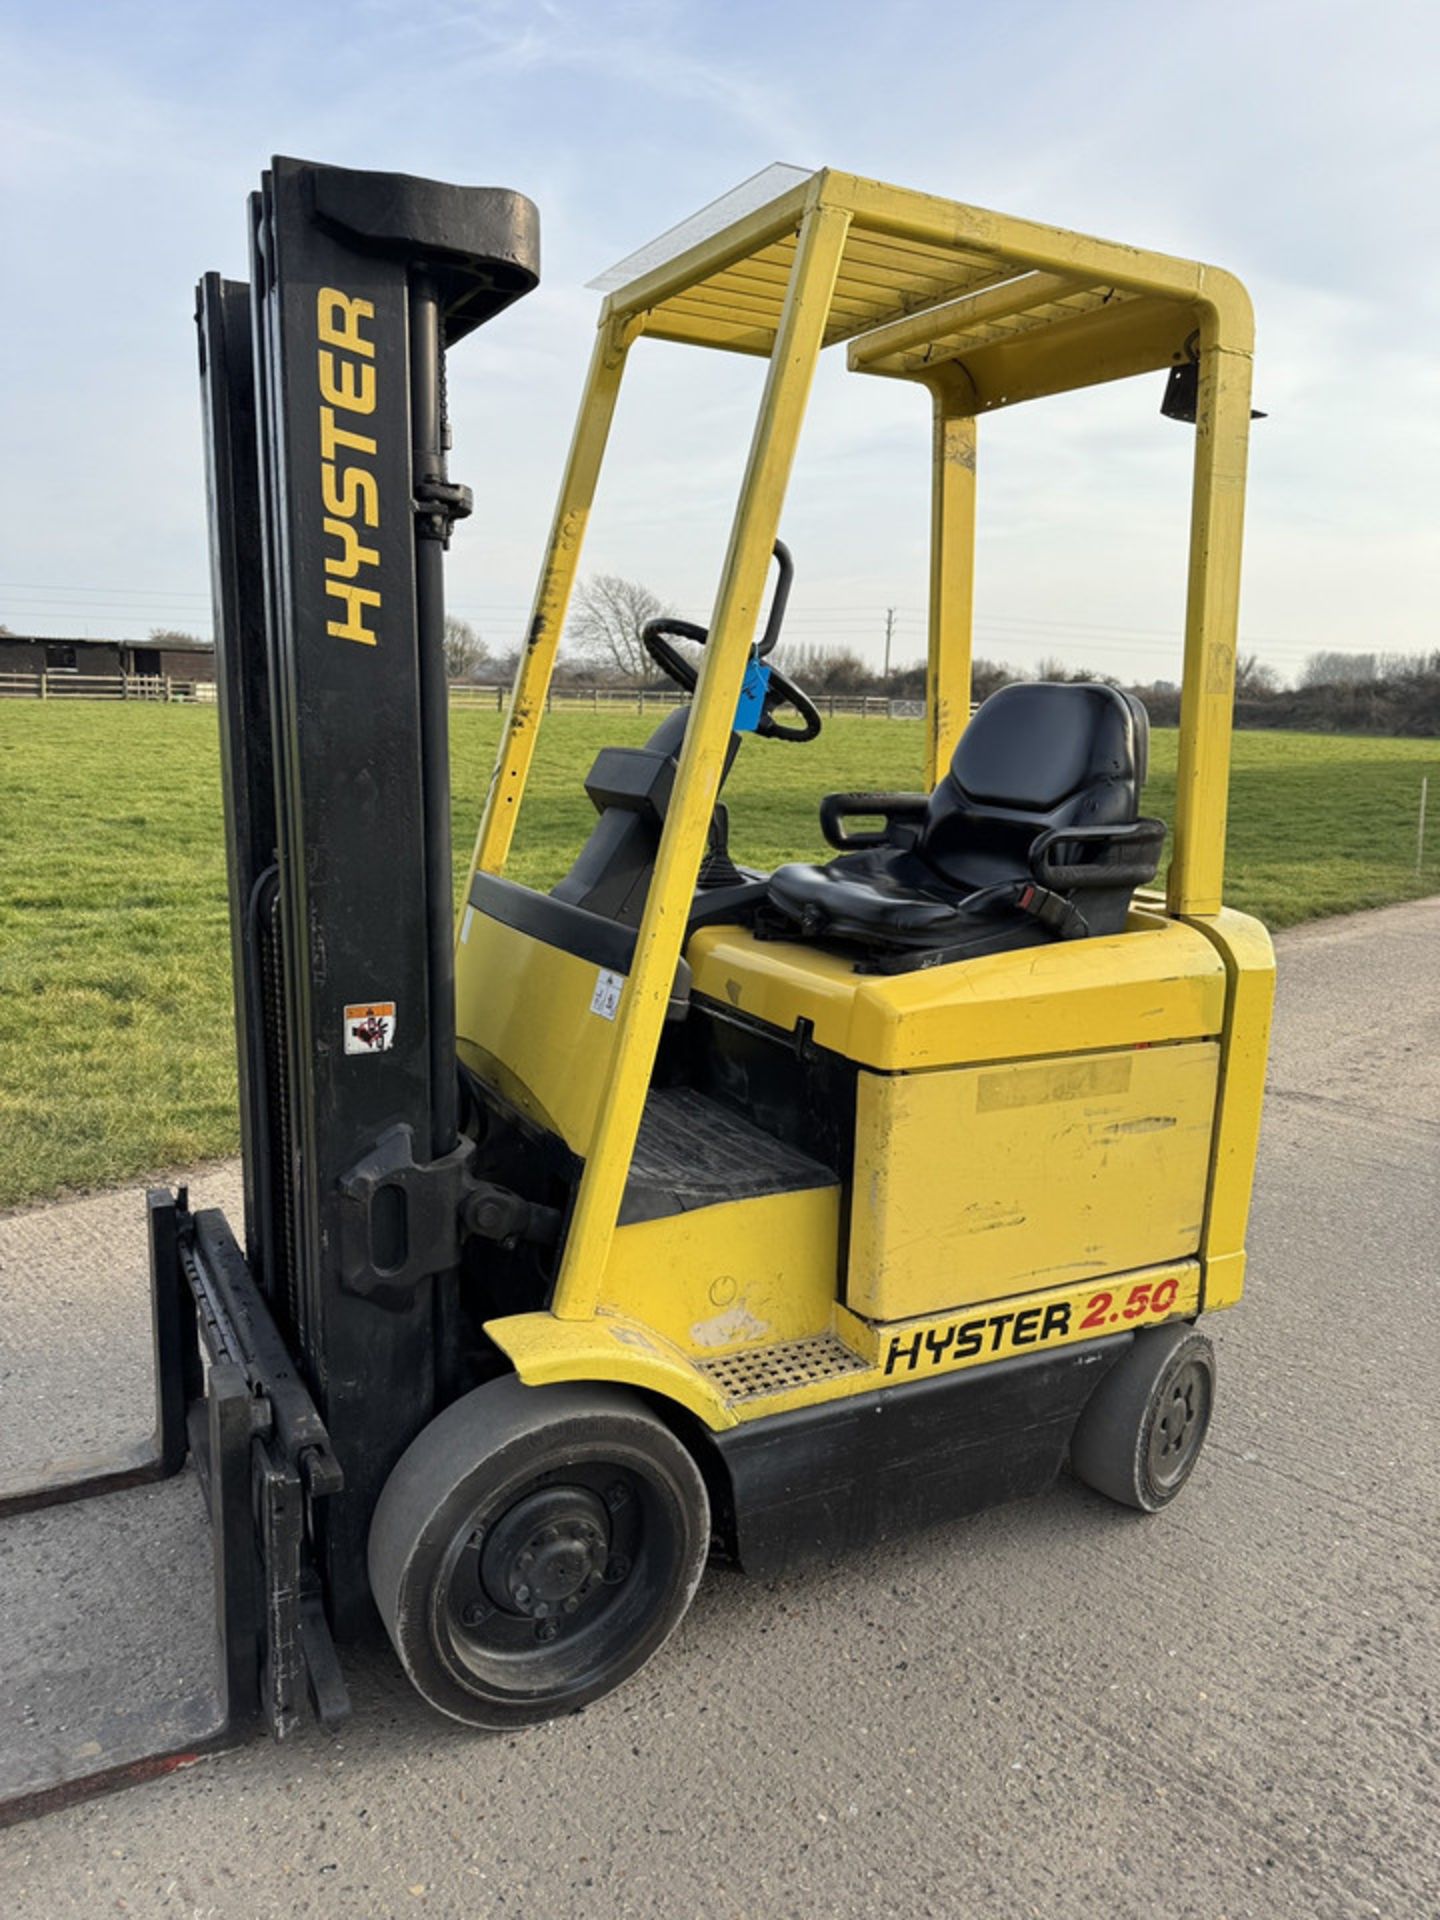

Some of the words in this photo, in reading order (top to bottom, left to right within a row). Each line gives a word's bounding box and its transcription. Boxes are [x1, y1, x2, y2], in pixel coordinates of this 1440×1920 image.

[317, 286, 381, 646] HYSTER
[883, 1301, 1072, 1376] HYSTER
[1078, 1278, 1180, 1330] 2.50
